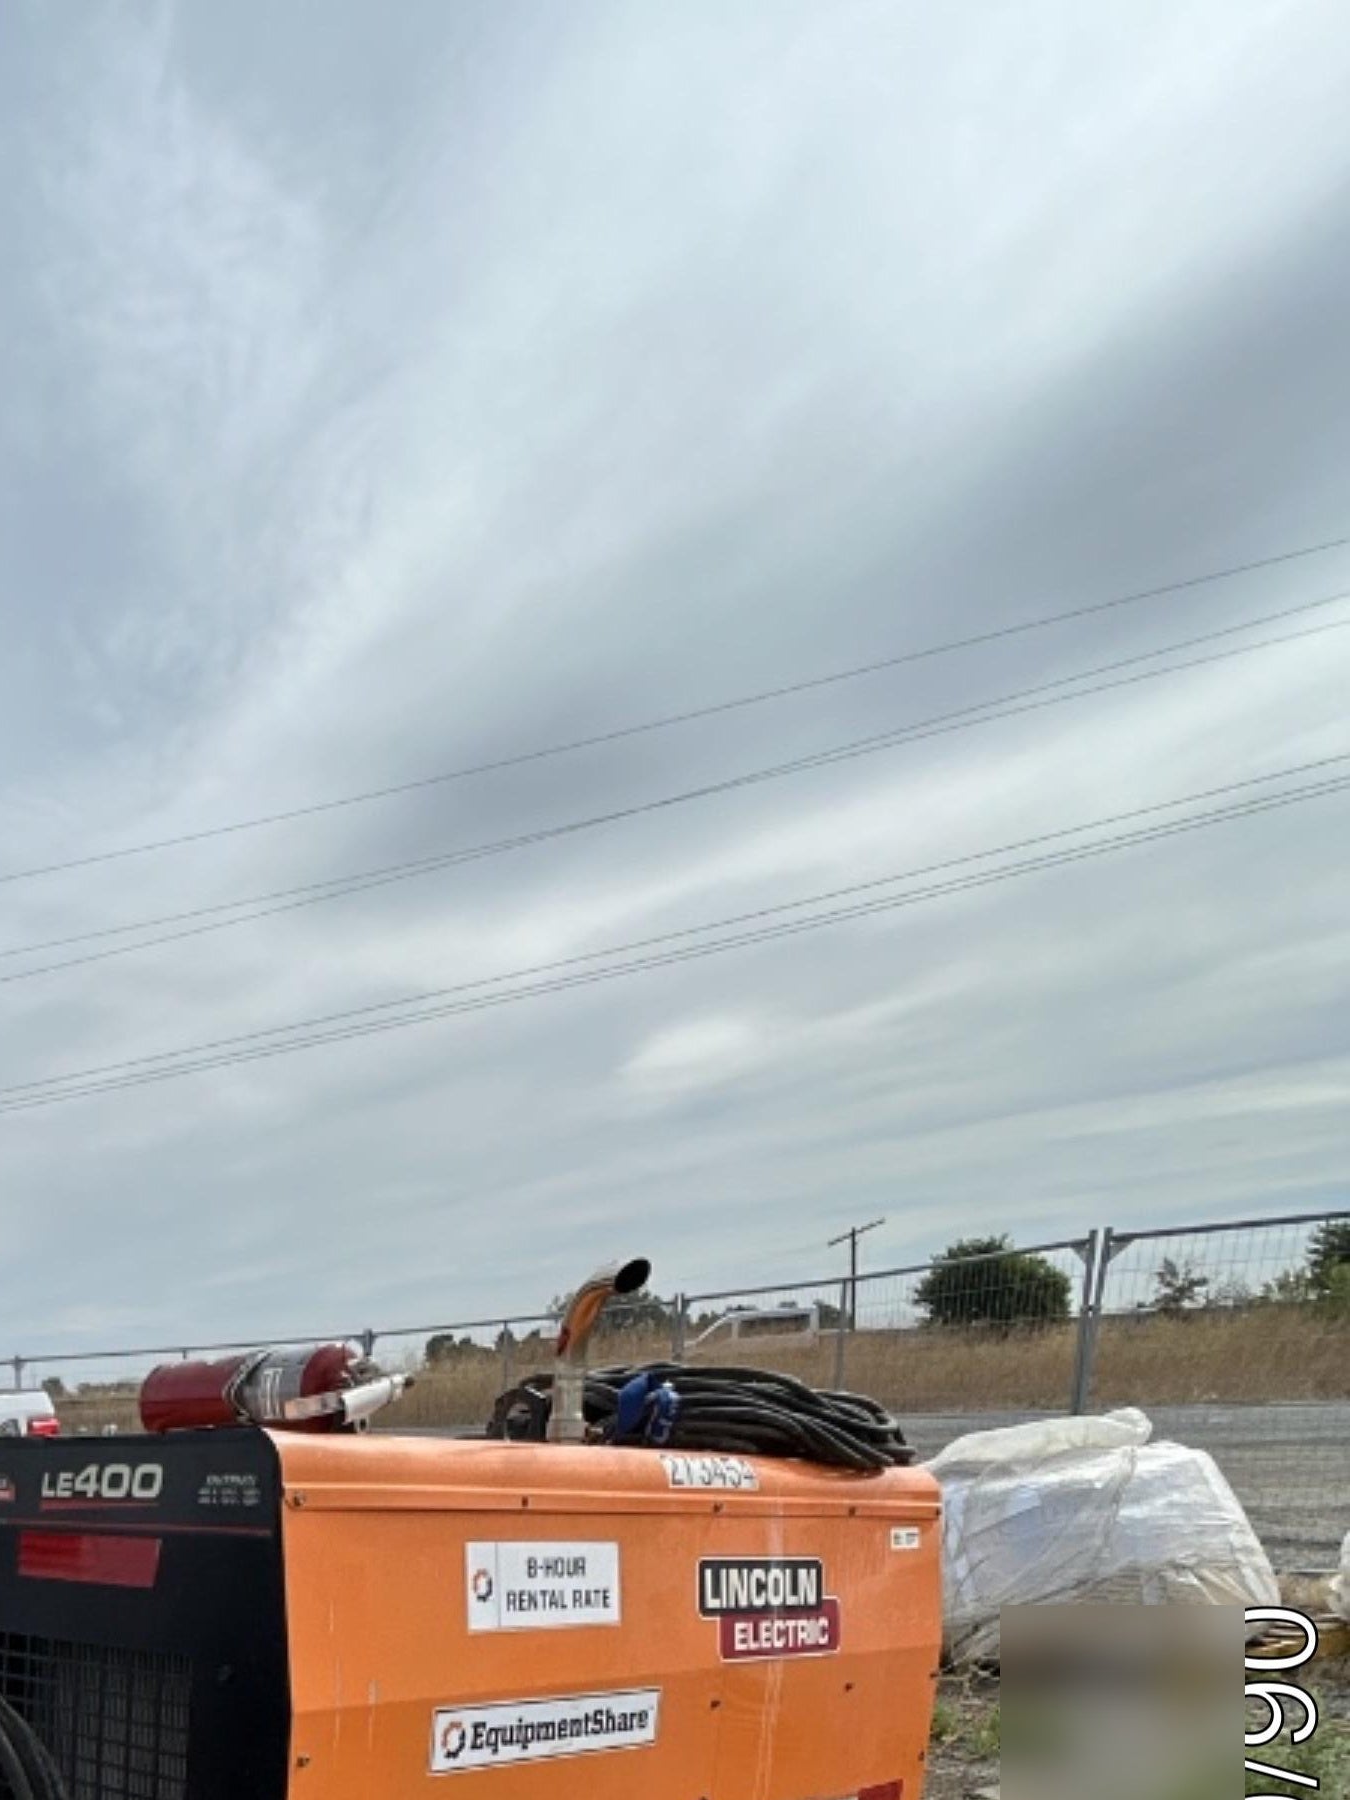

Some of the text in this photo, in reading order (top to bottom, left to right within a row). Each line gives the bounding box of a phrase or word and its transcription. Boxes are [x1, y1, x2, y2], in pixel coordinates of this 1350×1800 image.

[41, 1463, 163, 1499] LE400
[526, 1556, 586, 1579] 8-HOUR
[506, 1587, 611, 1612] RENTAL RATE
[703, 1566, 818, 1610] LINCOLN
[733, 1617, 830, 1652] ELECTRIC
[469, 1709, 649, 1752] EquipmentShare
